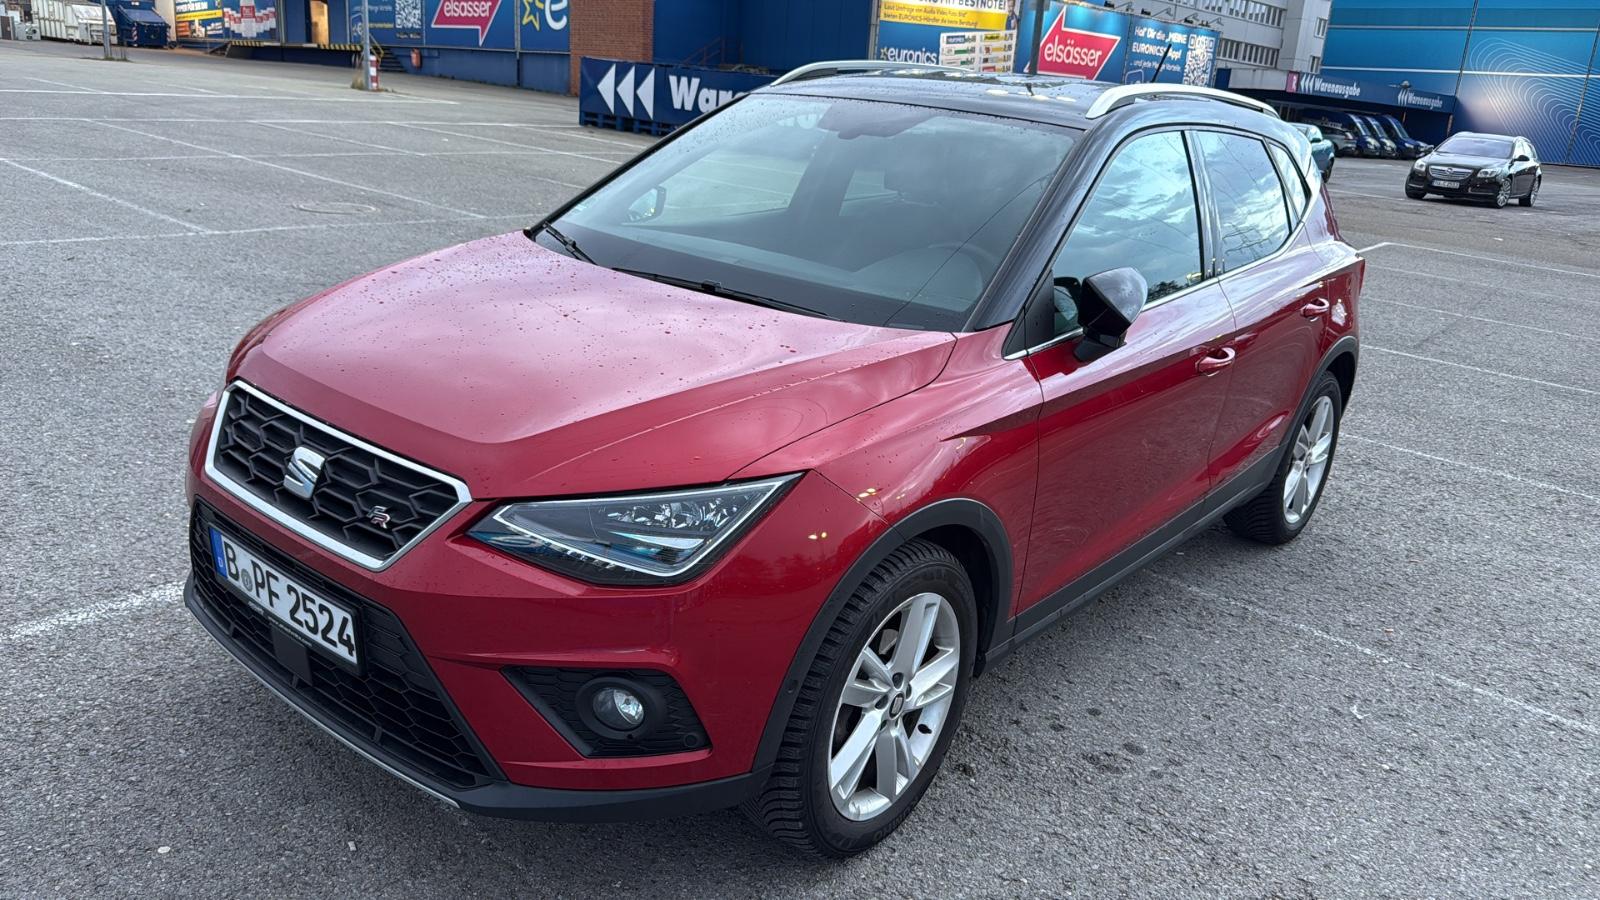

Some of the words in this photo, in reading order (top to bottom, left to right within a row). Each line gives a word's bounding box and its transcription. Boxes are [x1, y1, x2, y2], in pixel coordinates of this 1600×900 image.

[887, 47, 938, 66] euronics
[1044, 35, 1102, 67] elsässer
[1314, 77, 1361, 98] Warenausgabe
[1407, 91, 1443, 110] Warenausgabe
[251, 560, 280, 609] PF
[287, 585, 356, 657] 2524
